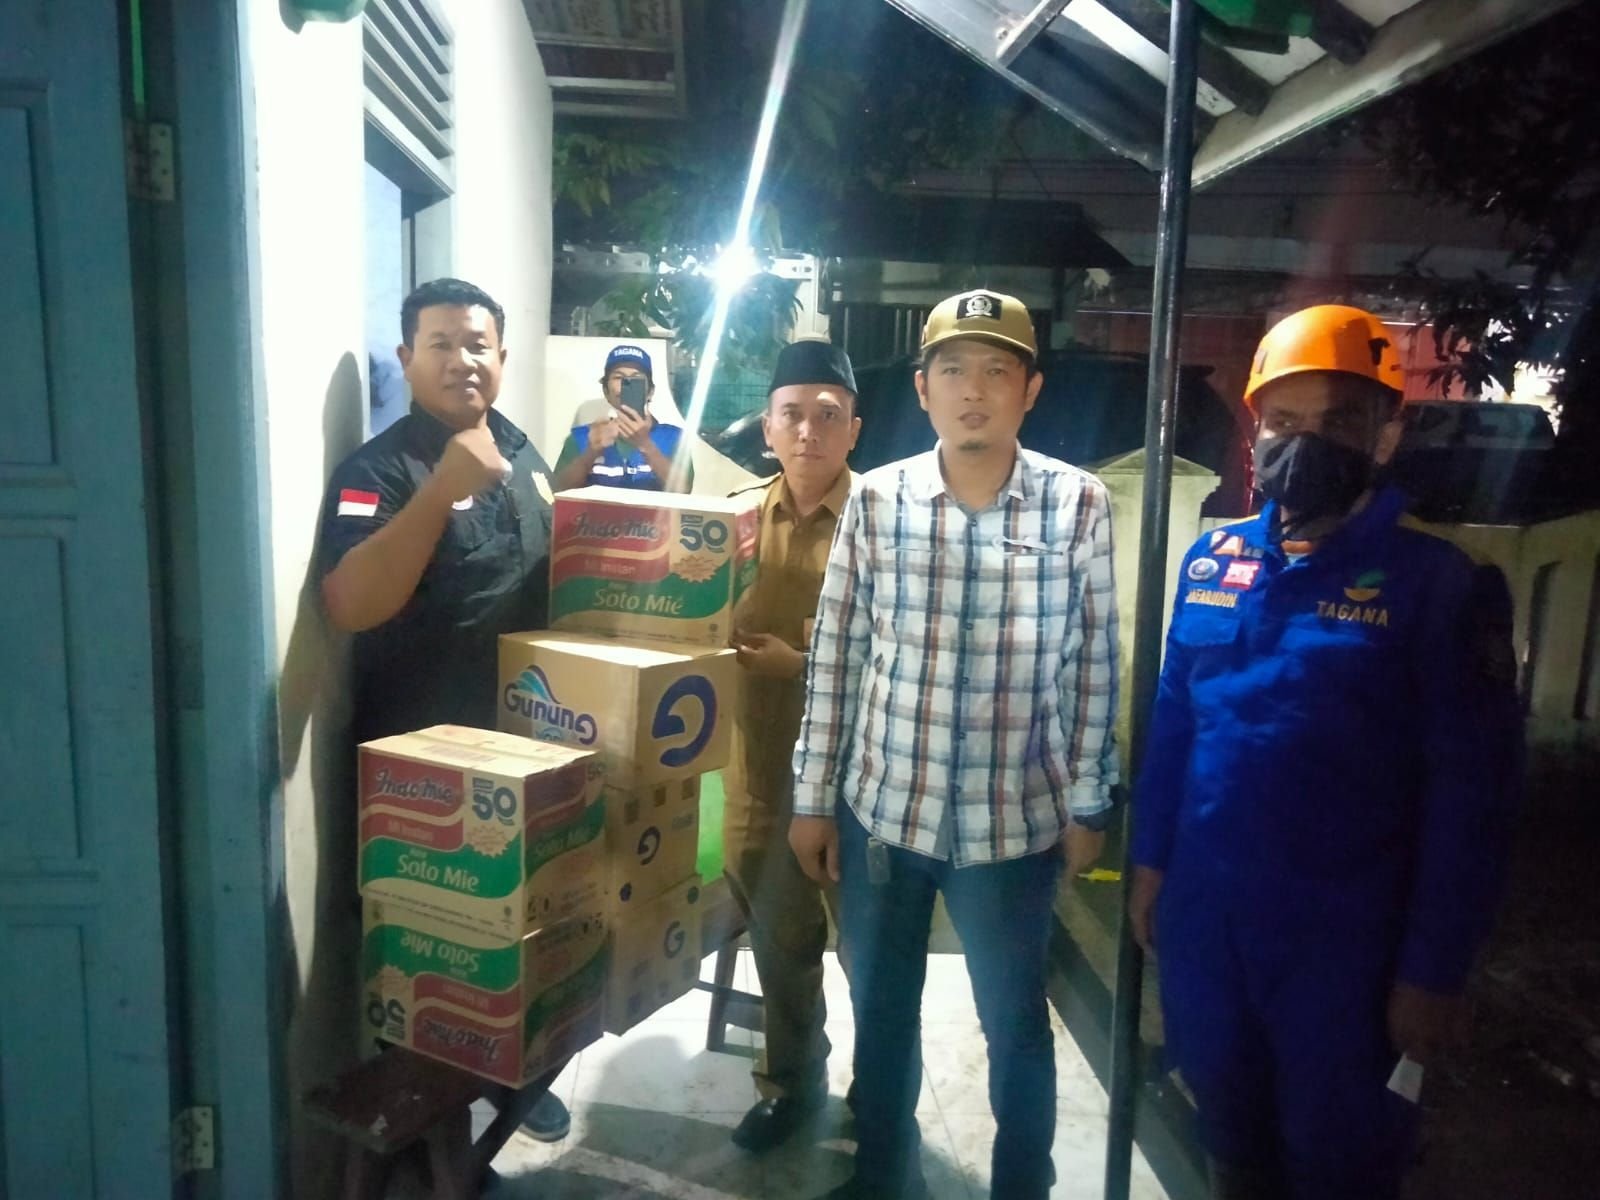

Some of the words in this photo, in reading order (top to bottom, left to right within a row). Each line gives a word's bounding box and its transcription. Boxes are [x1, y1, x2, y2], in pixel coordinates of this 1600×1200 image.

[614, 348, 643, 359] TAGANA
[592, 588, 640, 610] Soto
[644, 593, 685, 615] Mie
[1316, 600, 1389, 628] TAGANA
[397, 853, 439, 882] Soto
[443, 867, 479, 893] Mie
[400, 931, 433, 958] Mie
[437, 943, 480, 972] Soto
